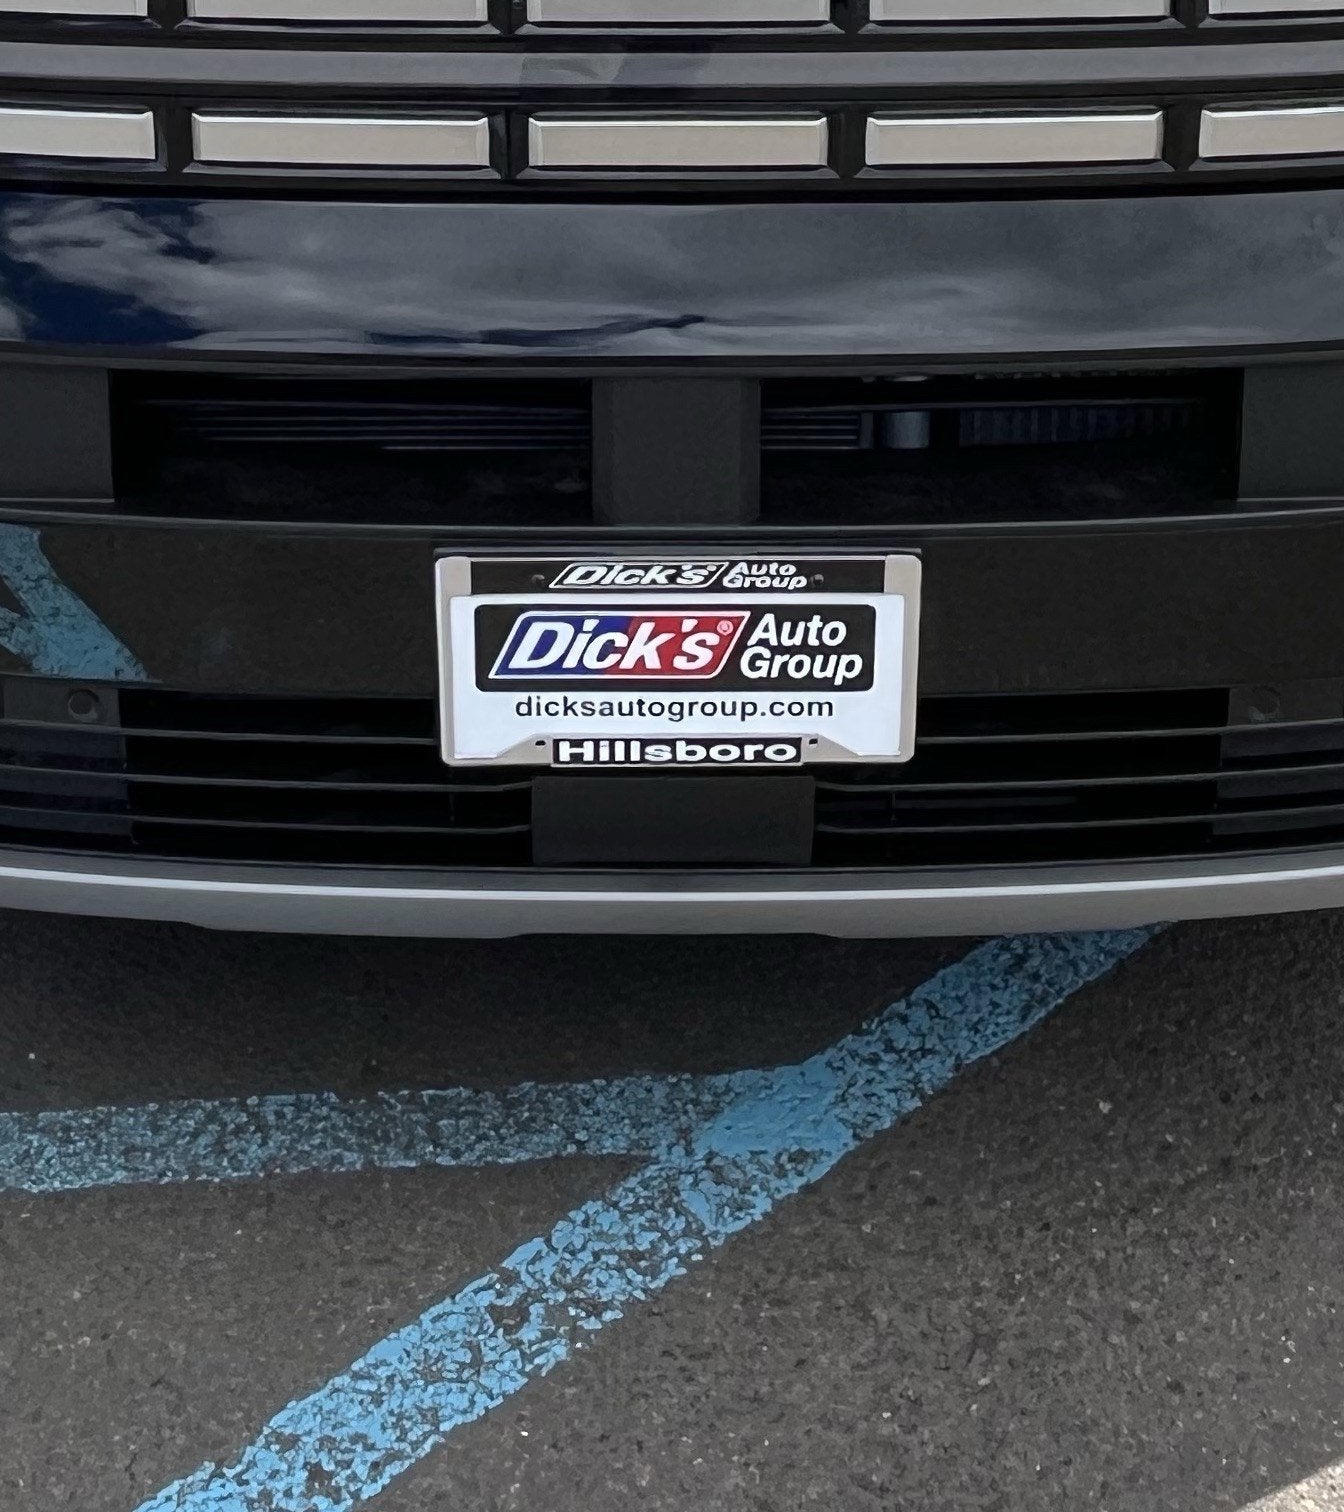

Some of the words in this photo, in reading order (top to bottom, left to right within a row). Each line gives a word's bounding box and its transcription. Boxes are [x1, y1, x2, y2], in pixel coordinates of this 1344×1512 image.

[722, 573, 808, 589] Group
[733, 562, 796, 576] Auto
[747, 614, 847, 646] Auto
[508, 619, 720, 670] Dick's
[740, 648, 863, 686] Group
[515, 696, 834, 722] dicksautogroup.com
[558, 739, 797, 762] Hillsboro
